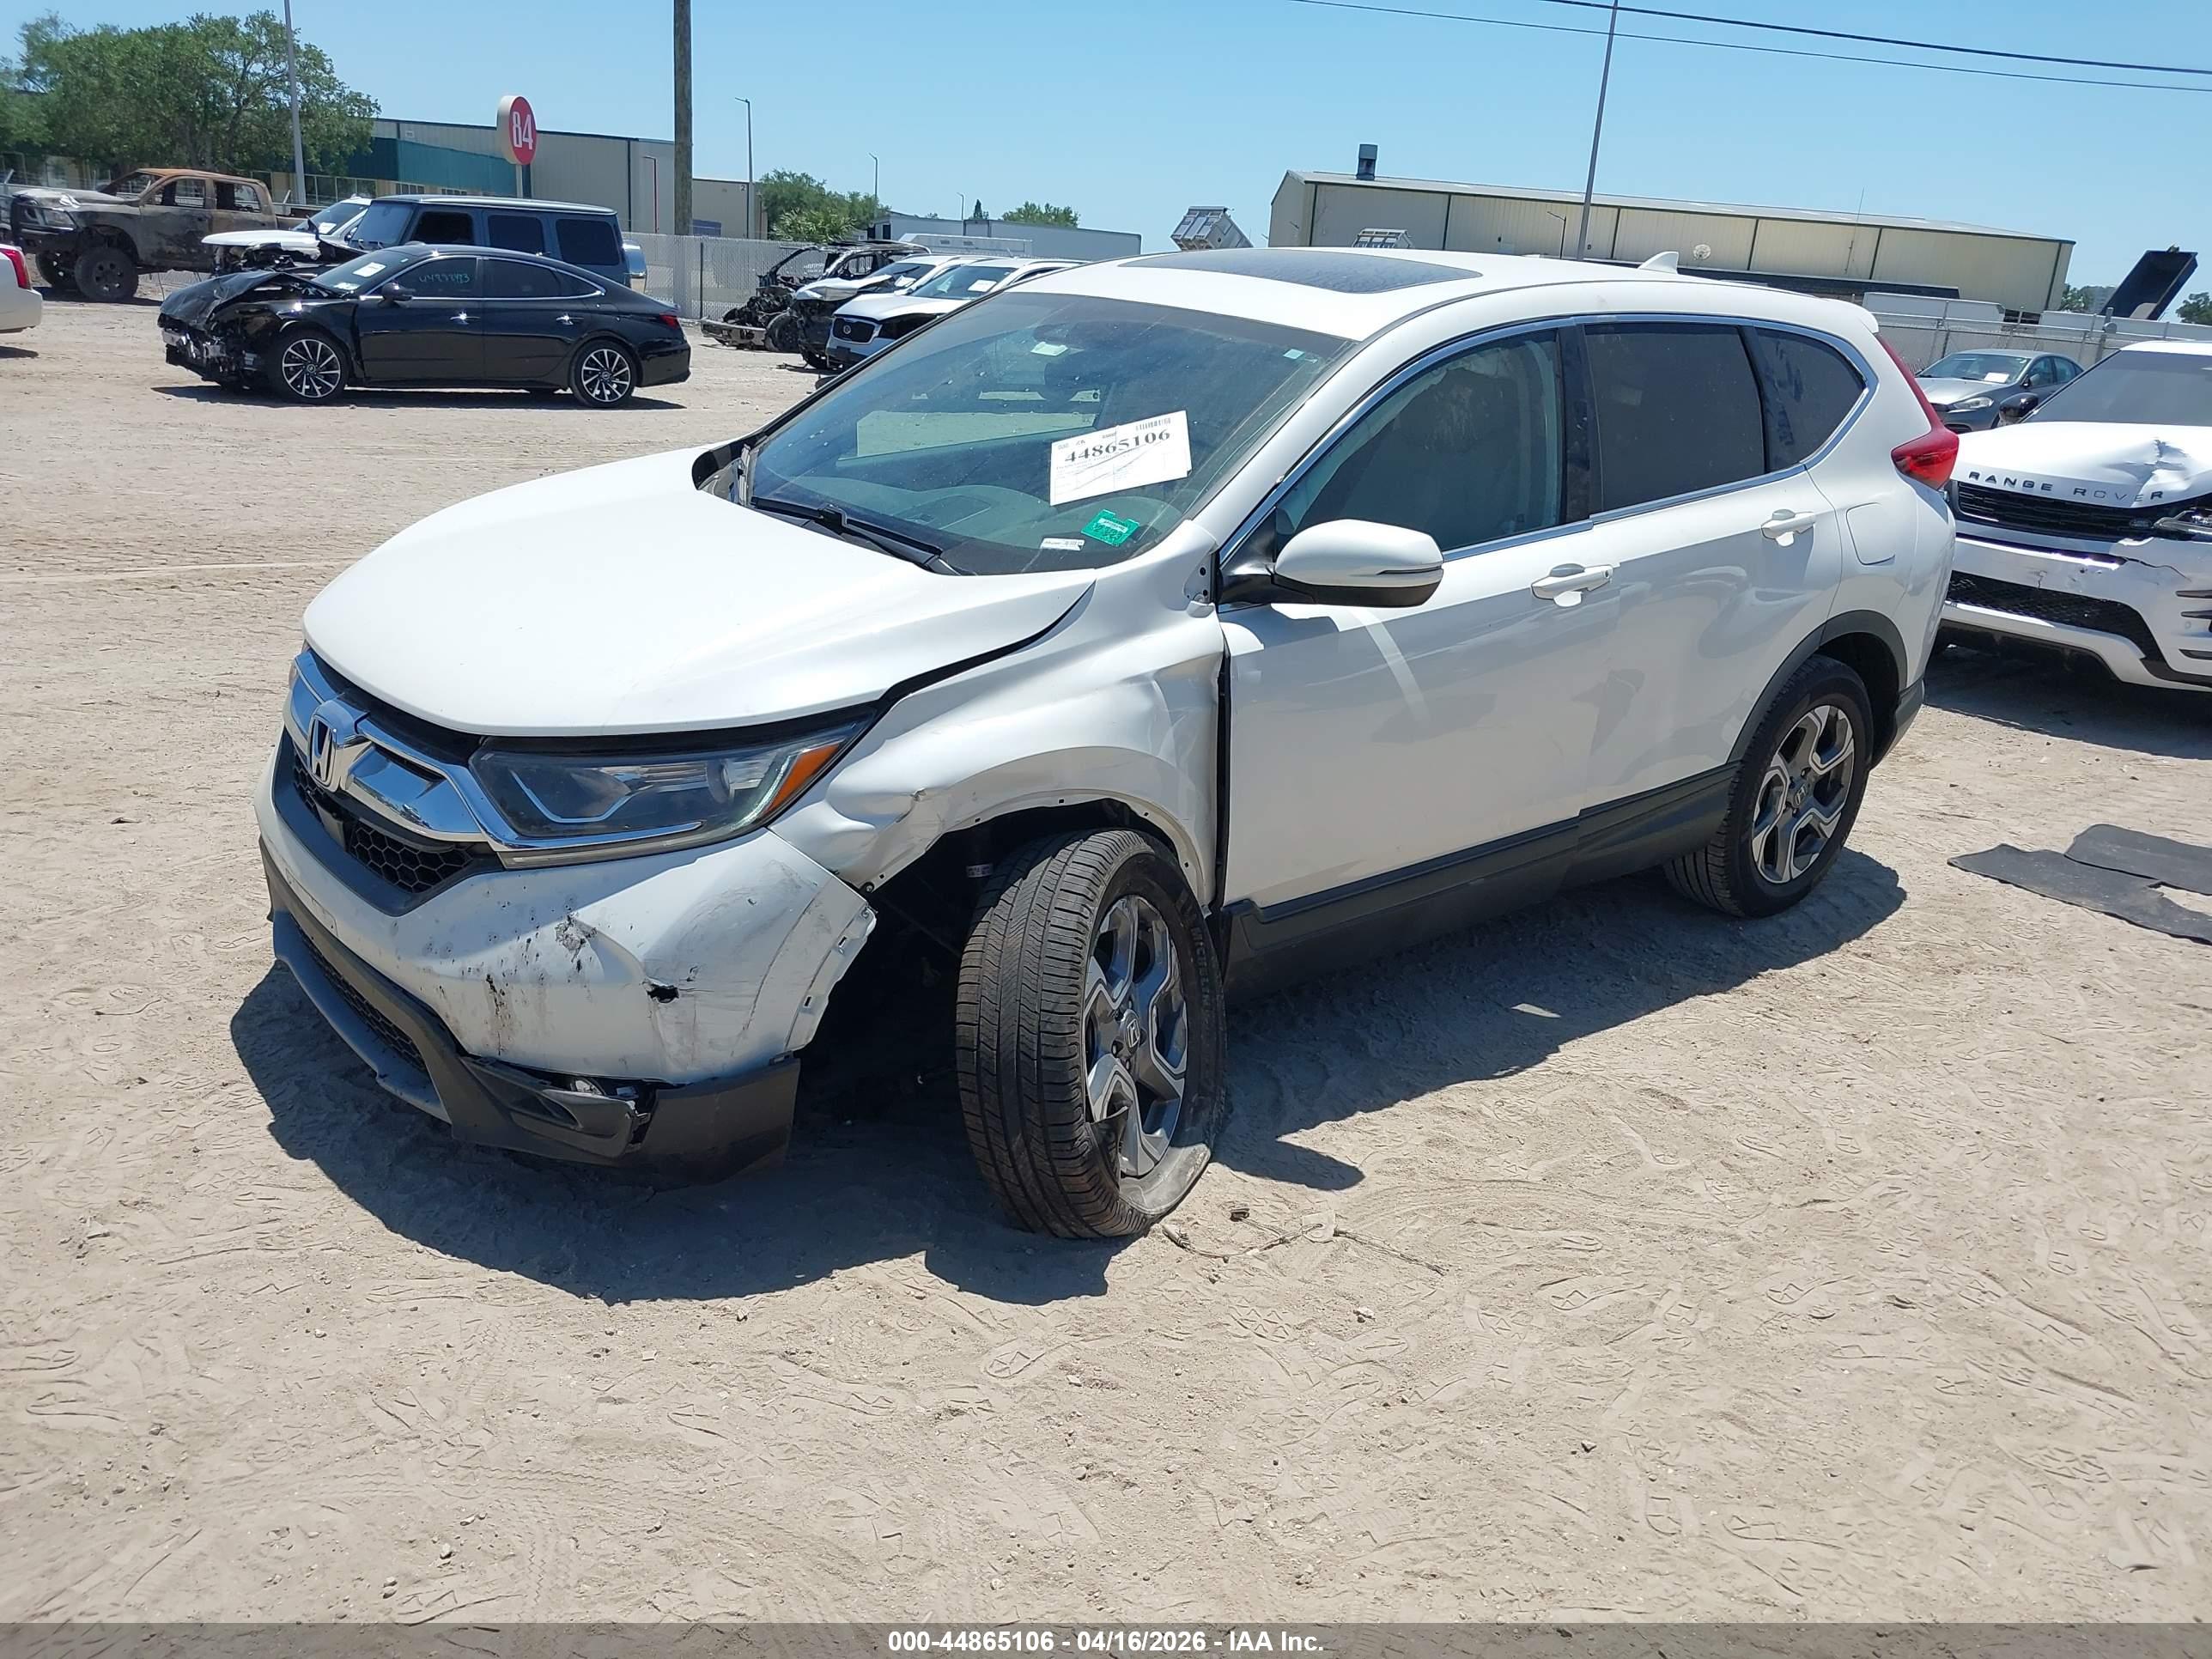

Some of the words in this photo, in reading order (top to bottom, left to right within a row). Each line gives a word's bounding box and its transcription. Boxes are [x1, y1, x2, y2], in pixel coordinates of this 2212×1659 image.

[512, 111, 533, 150] 84
[1064, 428, 1170, 464] 44865106
[1968, 471, 2054, 492] RANGE
[2072, 486, 2164, 503] ROVER
